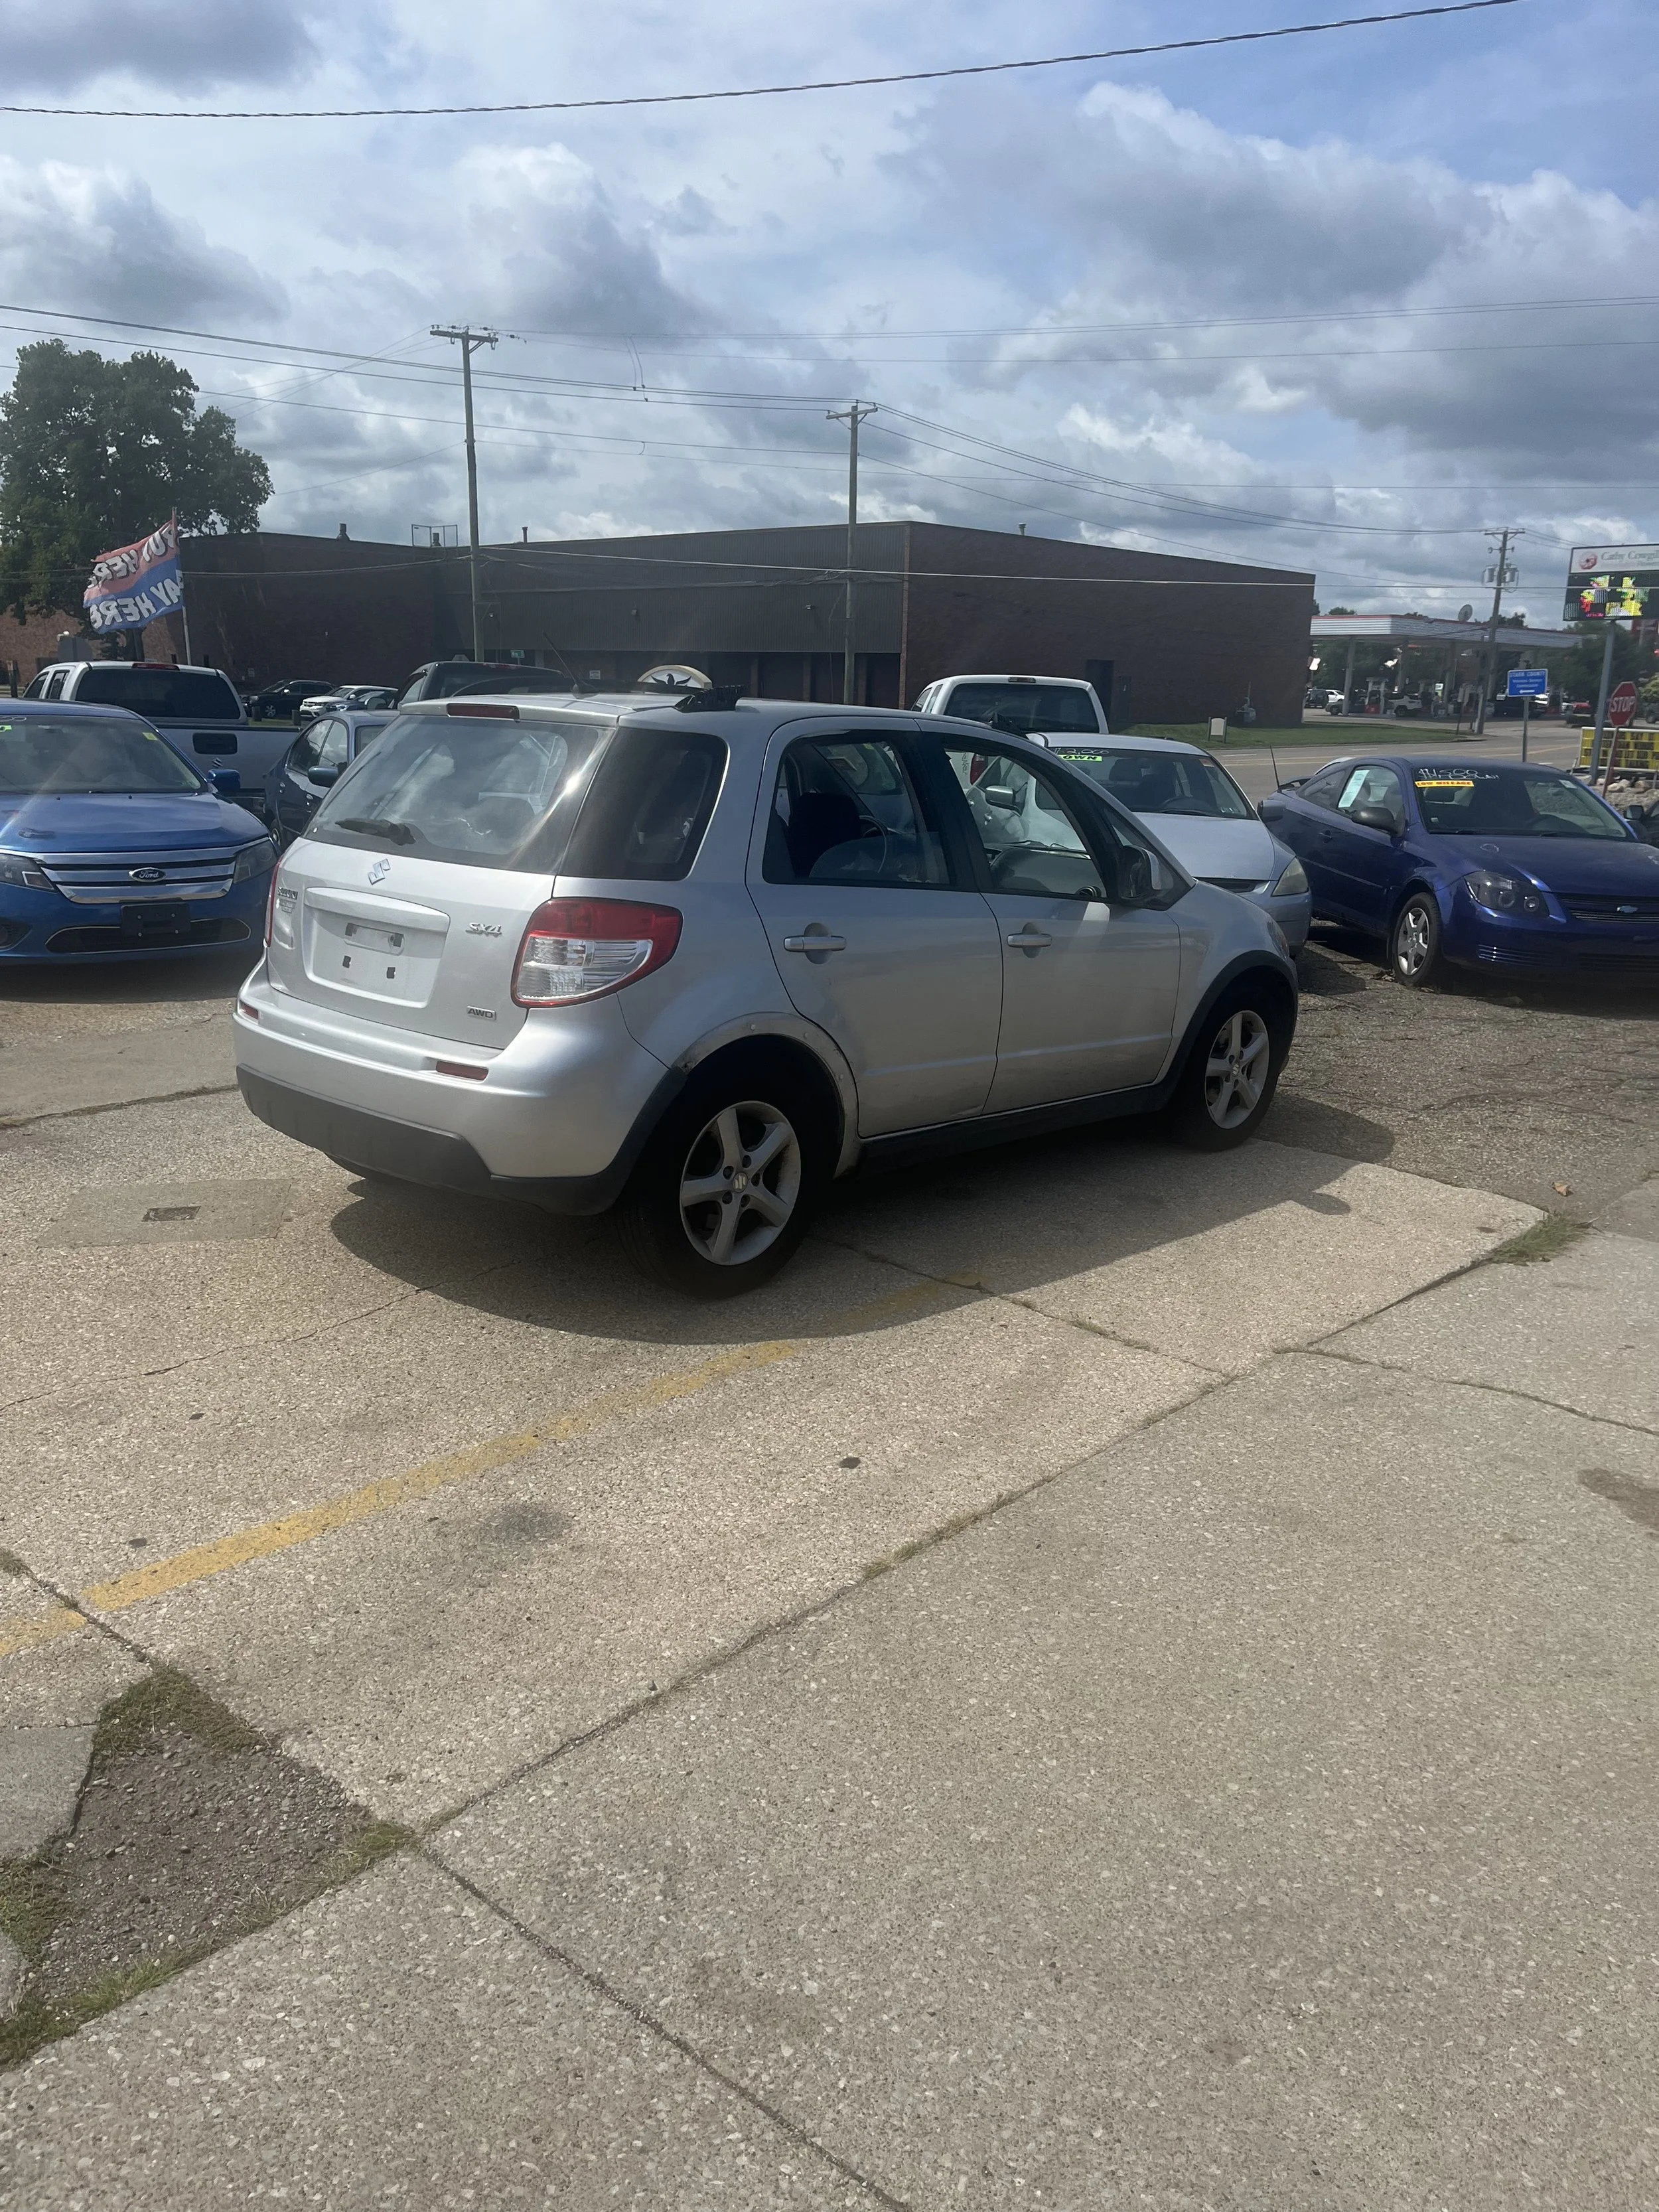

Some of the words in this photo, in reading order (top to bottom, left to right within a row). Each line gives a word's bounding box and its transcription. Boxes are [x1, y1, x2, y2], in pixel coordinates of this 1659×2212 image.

[1611, 696, 1636, 713] STOP
[139, 869, 160, 879] Ford
[466, 922, 502, 936] SX4
[467, 1007, 494, 1019] AWD
